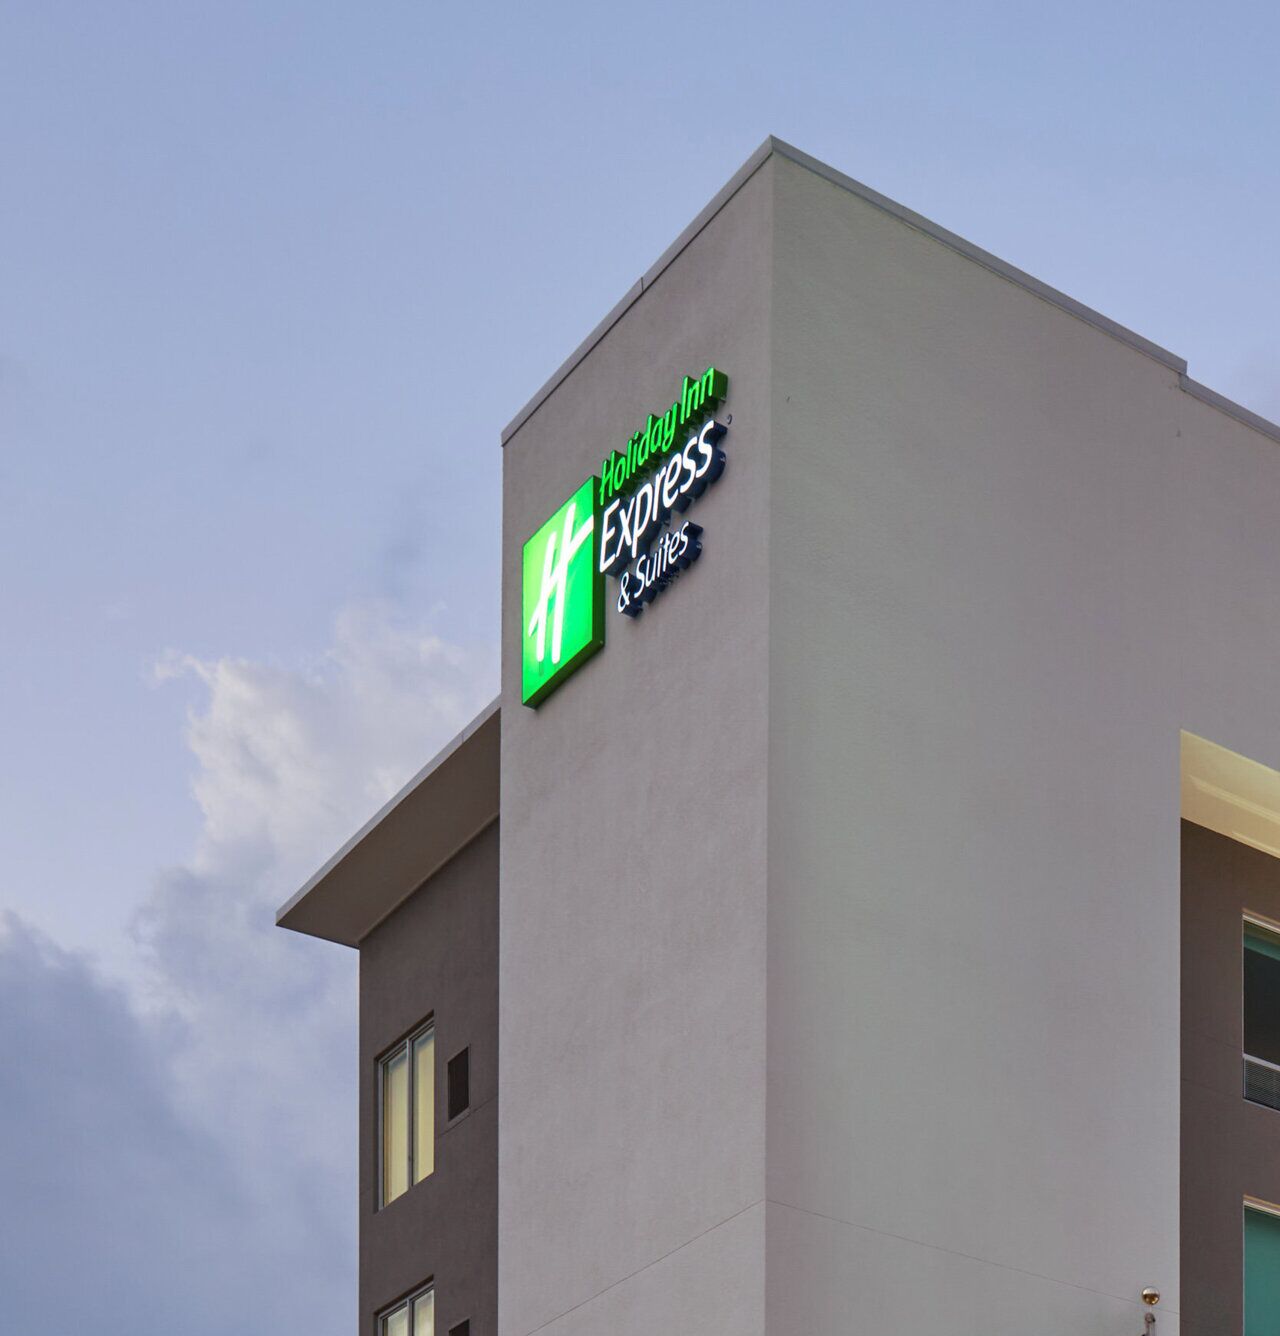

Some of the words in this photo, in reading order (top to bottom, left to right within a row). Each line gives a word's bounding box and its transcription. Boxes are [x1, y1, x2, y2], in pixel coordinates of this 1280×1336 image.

[599, 402, 678, 506] Holiday
[681, 367, 714, 425] Inn
[600, 419, 715, 574] Express
[617, 571, 630, 613] &
[633, 521, 690, 599] Suites
